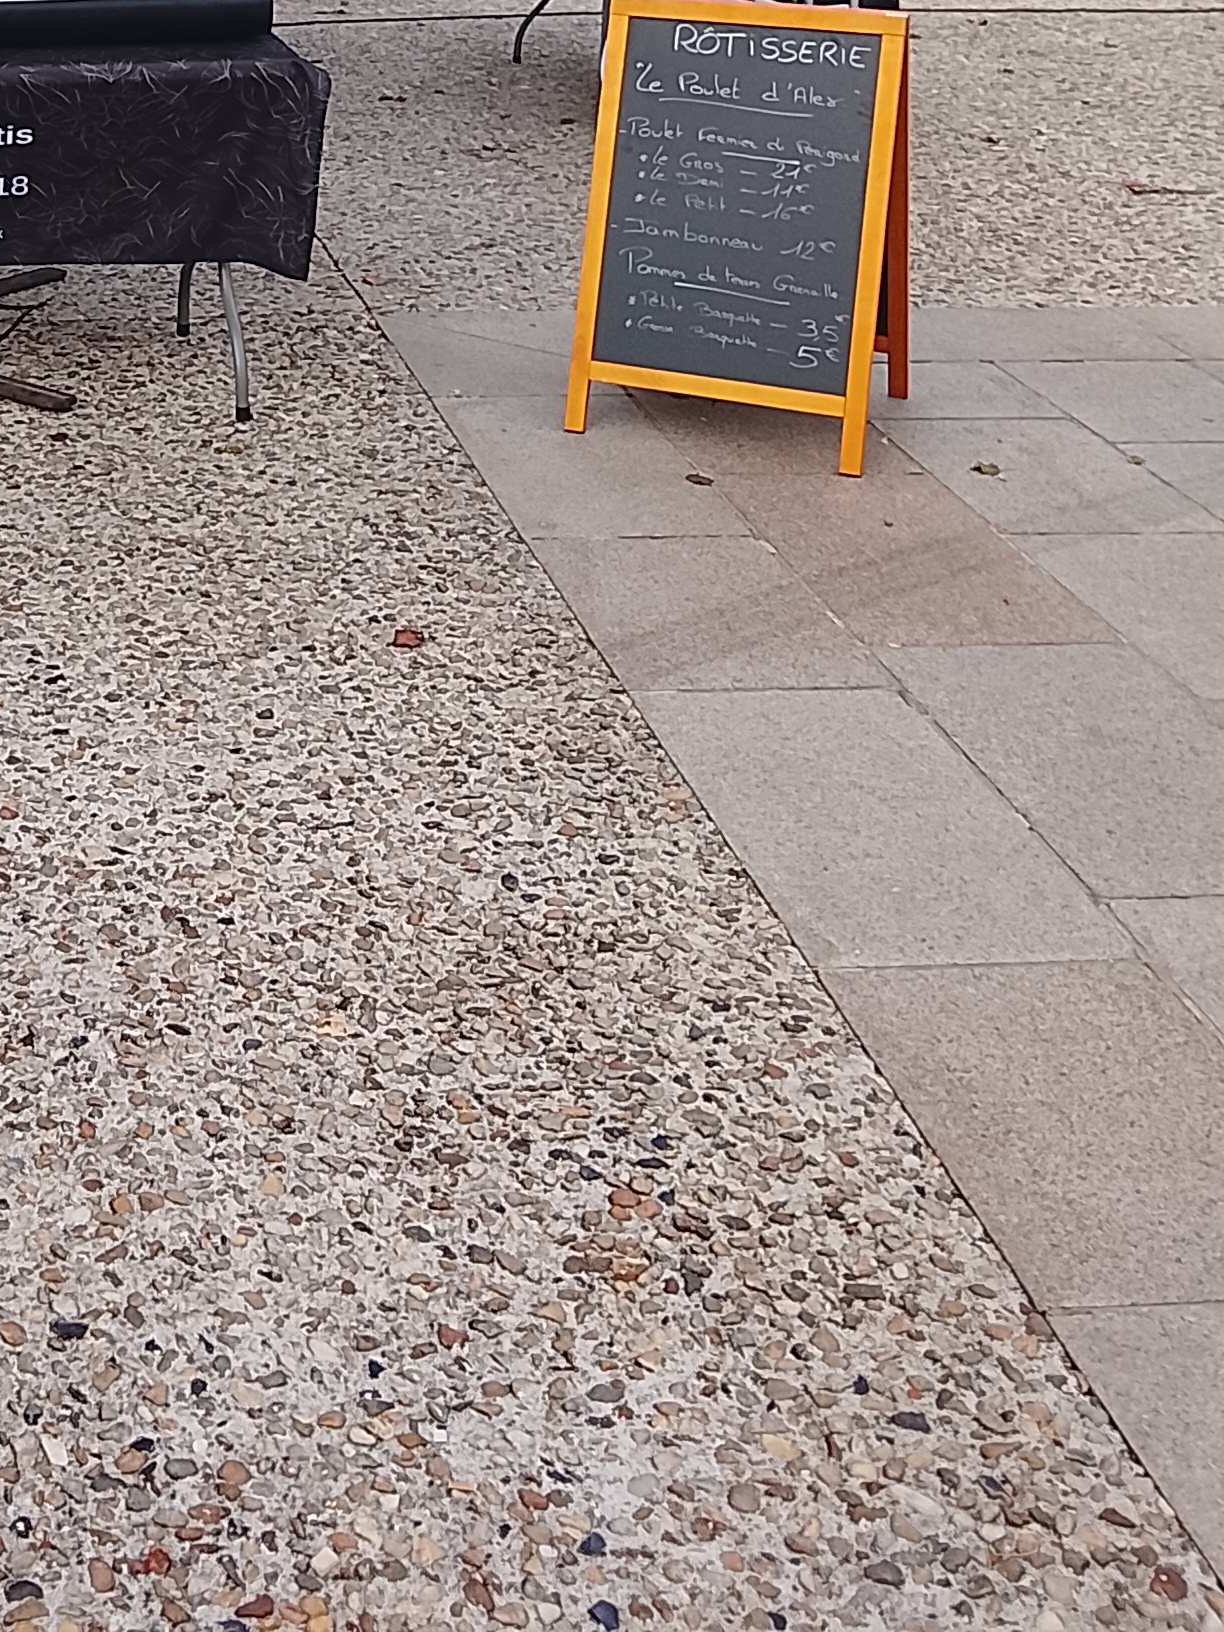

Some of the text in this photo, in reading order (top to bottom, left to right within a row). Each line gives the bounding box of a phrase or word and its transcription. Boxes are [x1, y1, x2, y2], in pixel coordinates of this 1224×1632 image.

[679, 72, 740, 100] Poulet
[623, 218, 764, 251] Jambonneau
[698, 265, 717, 282] de
